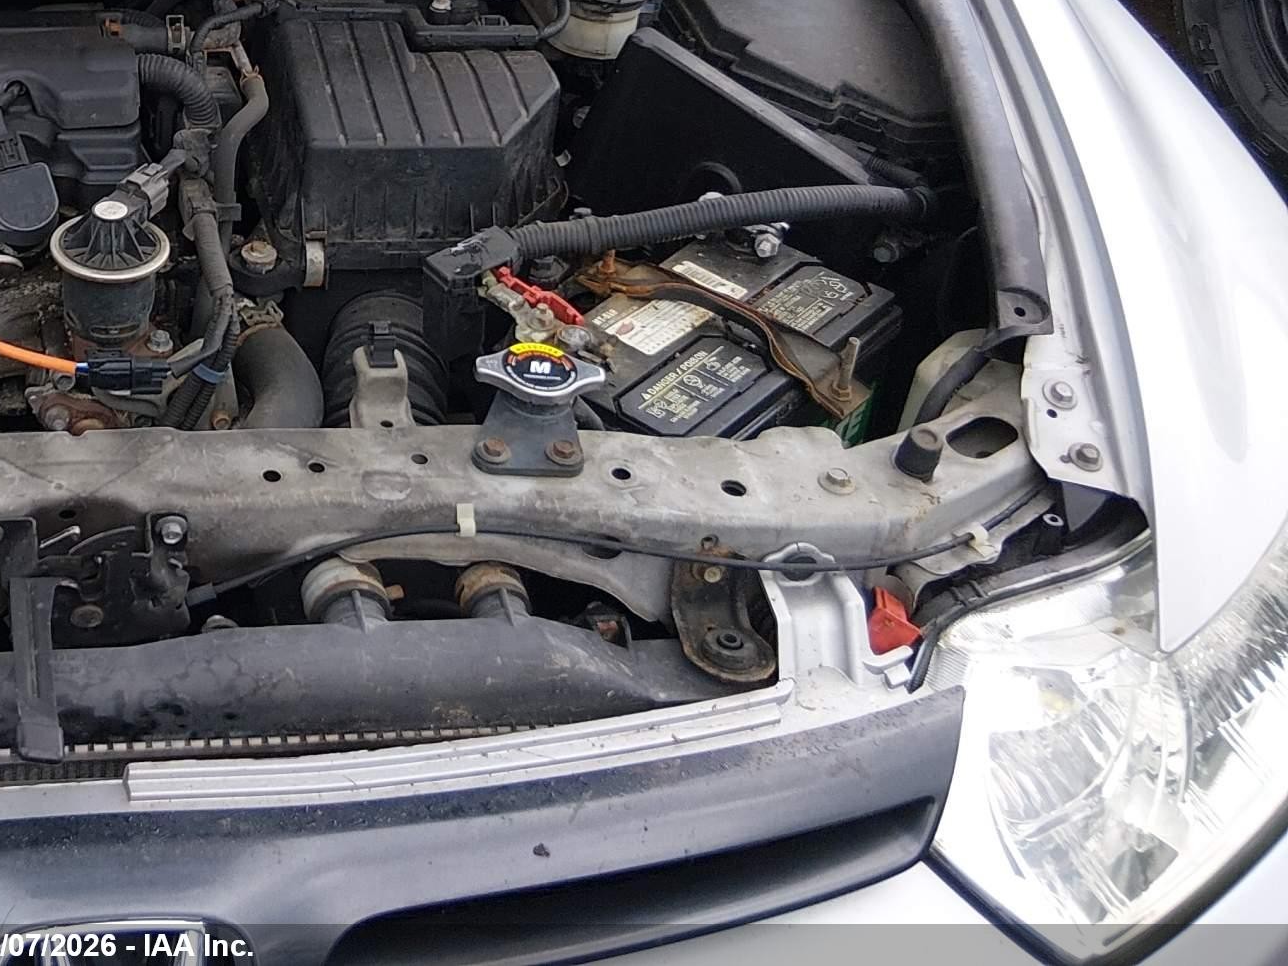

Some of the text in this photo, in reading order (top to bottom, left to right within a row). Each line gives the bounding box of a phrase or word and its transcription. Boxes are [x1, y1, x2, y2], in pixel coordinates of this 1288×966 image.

[529, 360, 552, 375] M
[648, 370, 679, 395] DANGER
[680, 350, 708, 371] POISON
